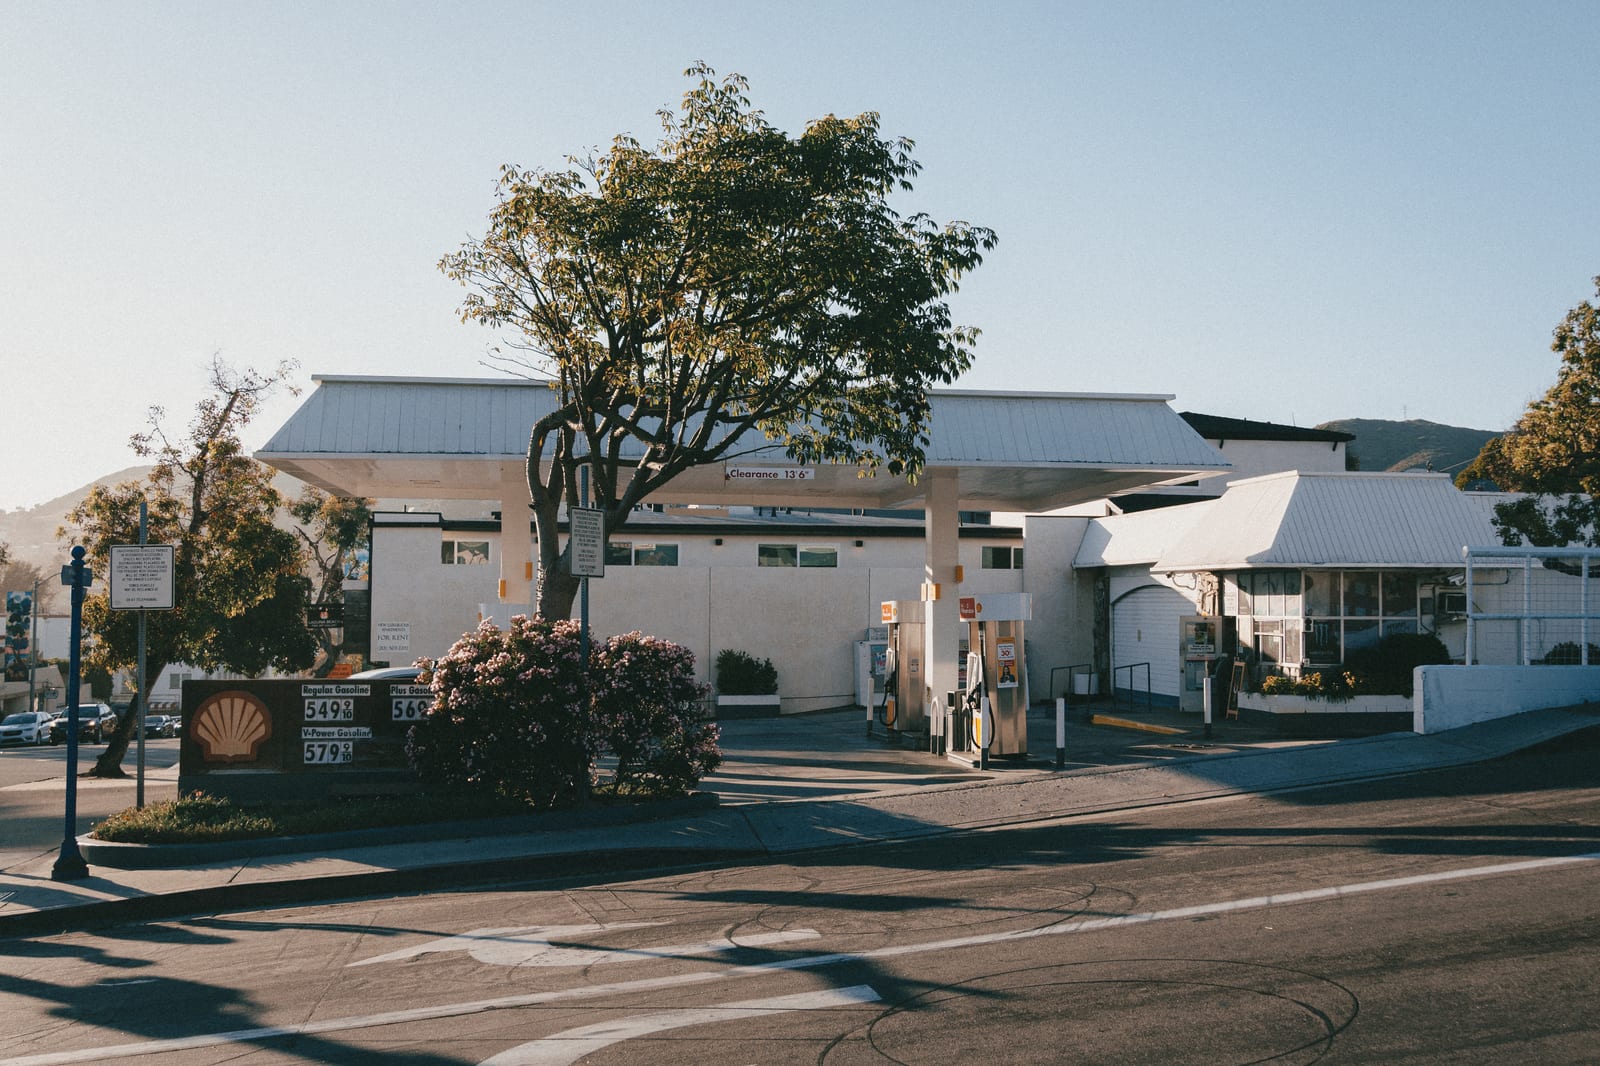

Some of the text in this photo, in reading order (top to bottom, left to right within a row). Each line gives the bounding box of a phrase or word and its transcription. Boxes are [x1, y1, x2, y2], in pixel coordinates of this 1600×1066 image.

[730, 469, 778, 479] Clearance
[303, 685, 369, 696] Regular Gasoline
[391, 685, 407, 695] Plus
[305, 701, 340, 719] 549
[303, 728, 371, 738] V-Power Gasoline
[305, 743, 340, 762] 579
